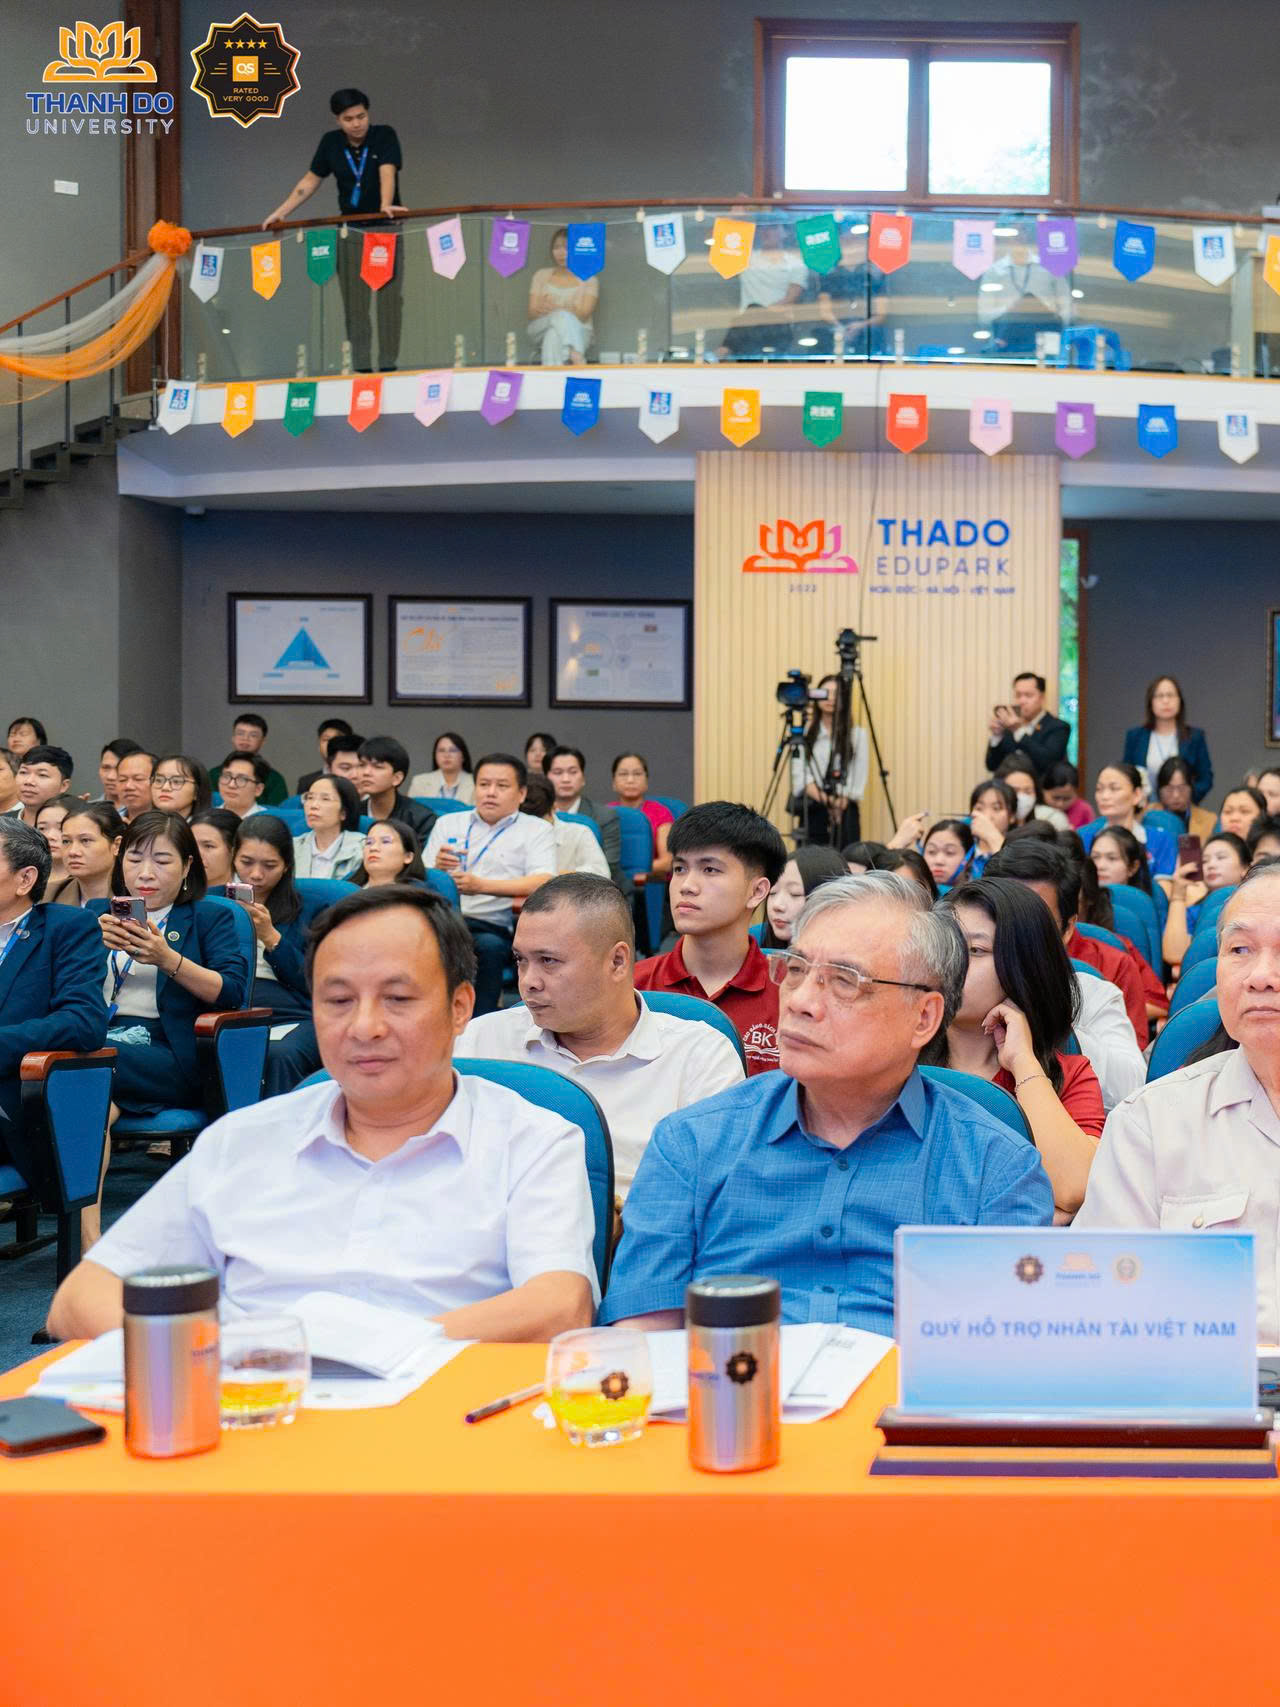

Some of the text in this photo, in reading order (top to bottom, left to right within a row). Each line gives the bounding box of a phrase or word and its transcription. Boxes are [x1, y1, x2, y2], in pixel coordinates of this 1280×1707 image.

[877, 519, 1010, 547] THADO
[876, 556, 1010, 576] EDUPARK
[752, 1031, 773, 1047] BK
[1144, 1315, 1187, 1339] VIỆT
[1193, 1319, 1237, 1337] NAM
